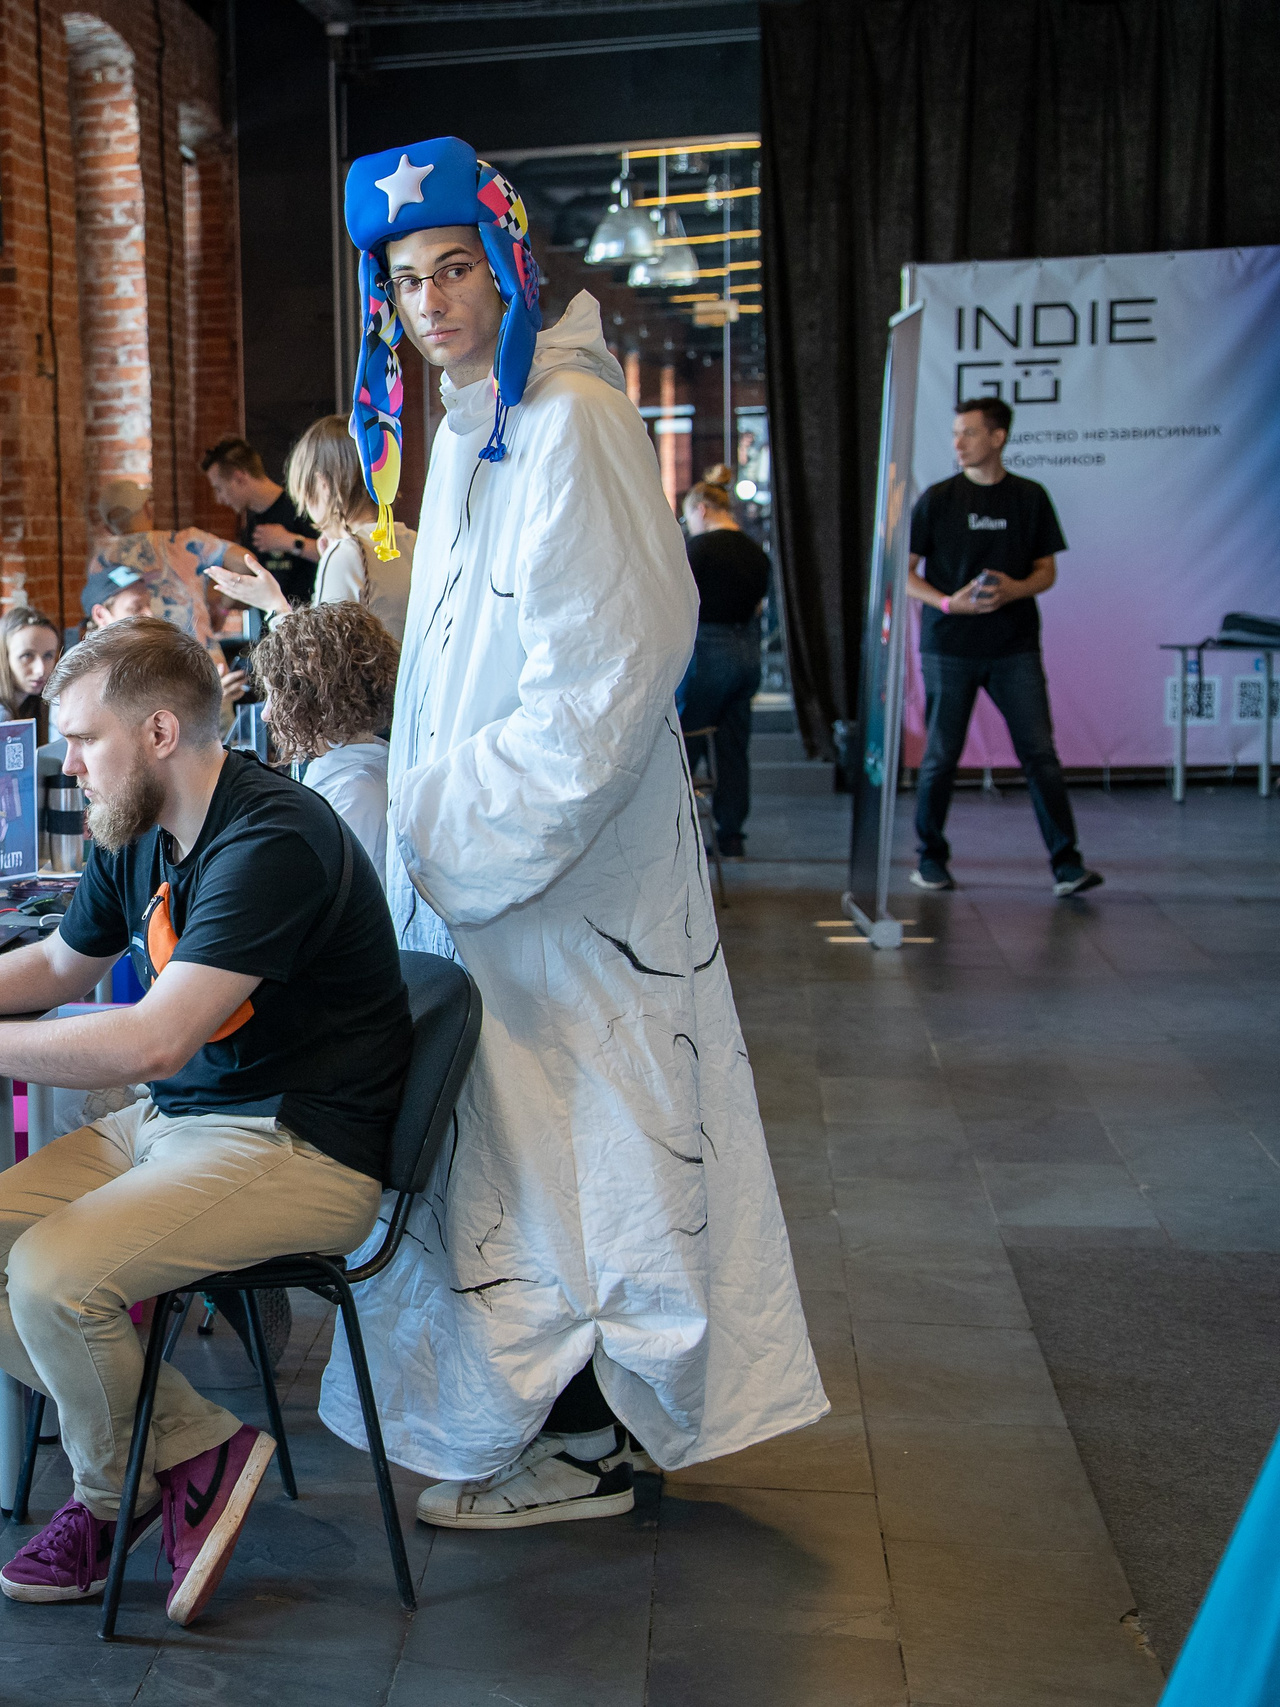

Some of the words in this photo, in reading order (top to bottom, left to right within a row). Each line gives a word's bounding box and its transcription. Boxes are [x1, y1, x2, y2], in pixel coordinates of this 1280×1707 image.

[955, 298, 1157, 351] INDIE
[1006, 428, 1079, 446] щество
[1082, 424, 1222, 443] независимых
